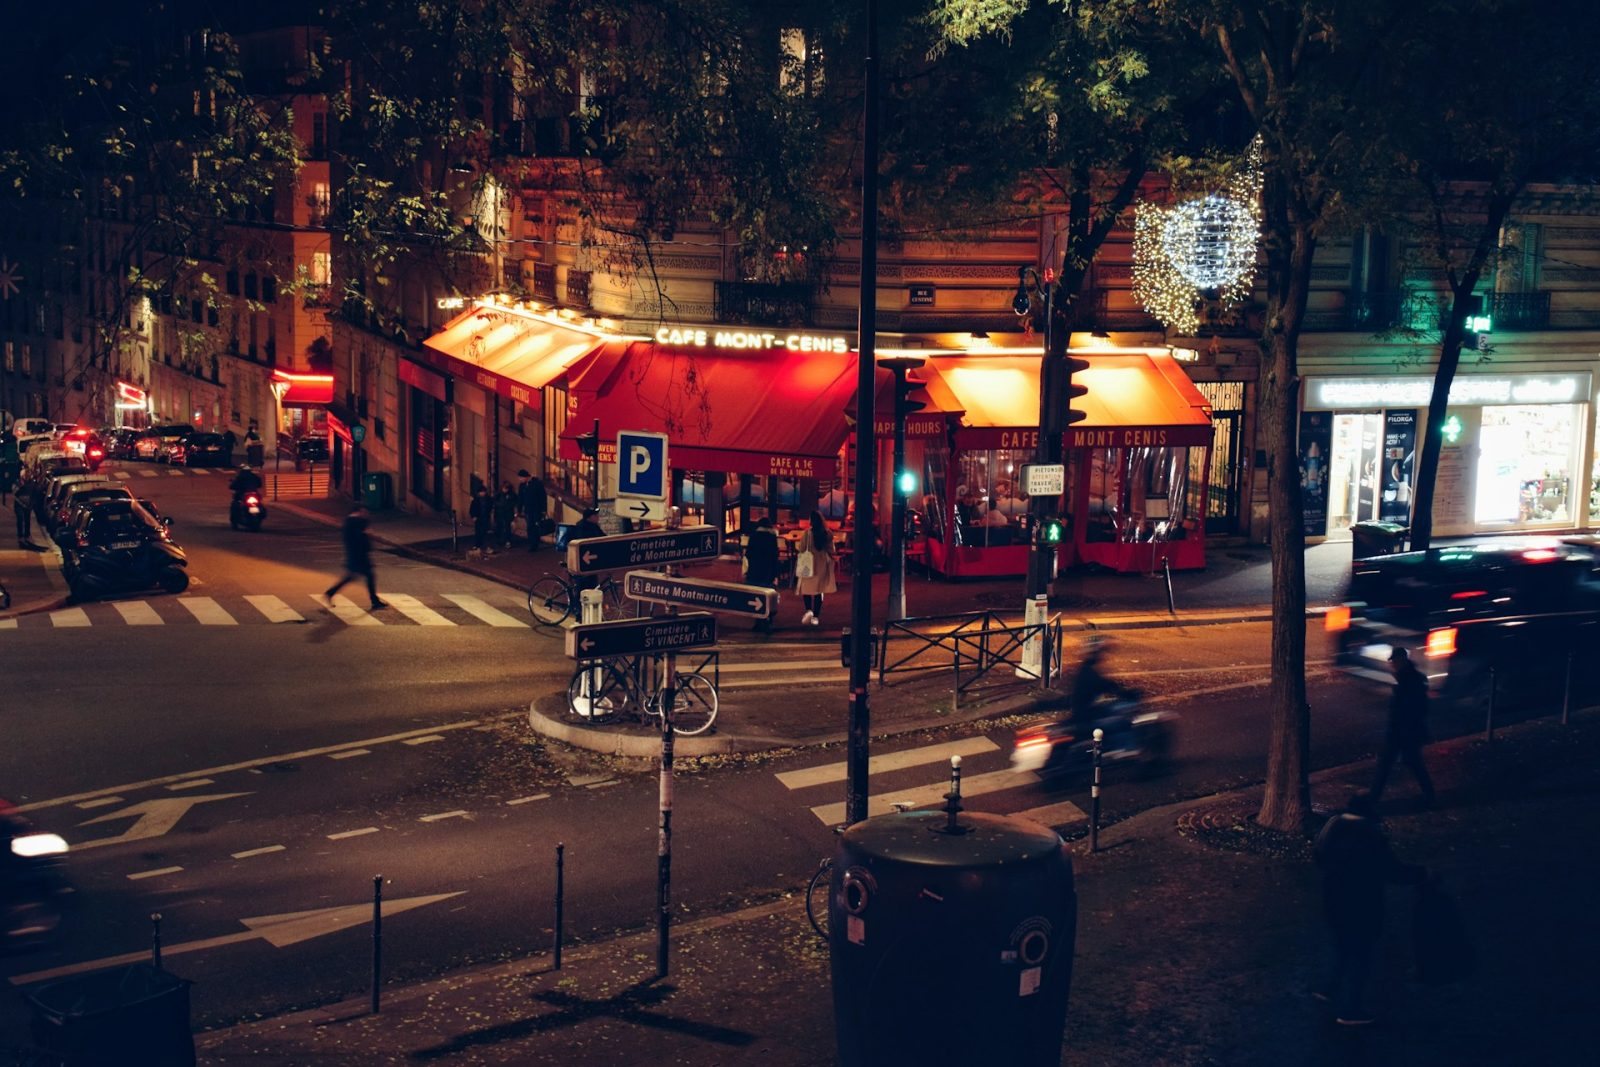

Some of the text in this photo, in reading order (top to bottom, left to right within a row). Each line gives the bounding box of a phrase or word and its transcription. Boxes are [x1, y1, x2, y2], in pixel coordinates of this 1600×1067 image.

[656, 327, 849, 353] CAFE MONT-CENIS
[908, 421, 941, 435] HOURS
[1001, 430, 1167, 448] CAFE MONT CENIS
[630, 445, 651, 484] P
[770, 457, 791, 468] CAFE
[795, 460, 800, 468] A
[631, 547, 699, 562] de Montmartre
[645, 582, 728, 604] Butte Montmartre
[657, 633, 697, 646] VINCENT
